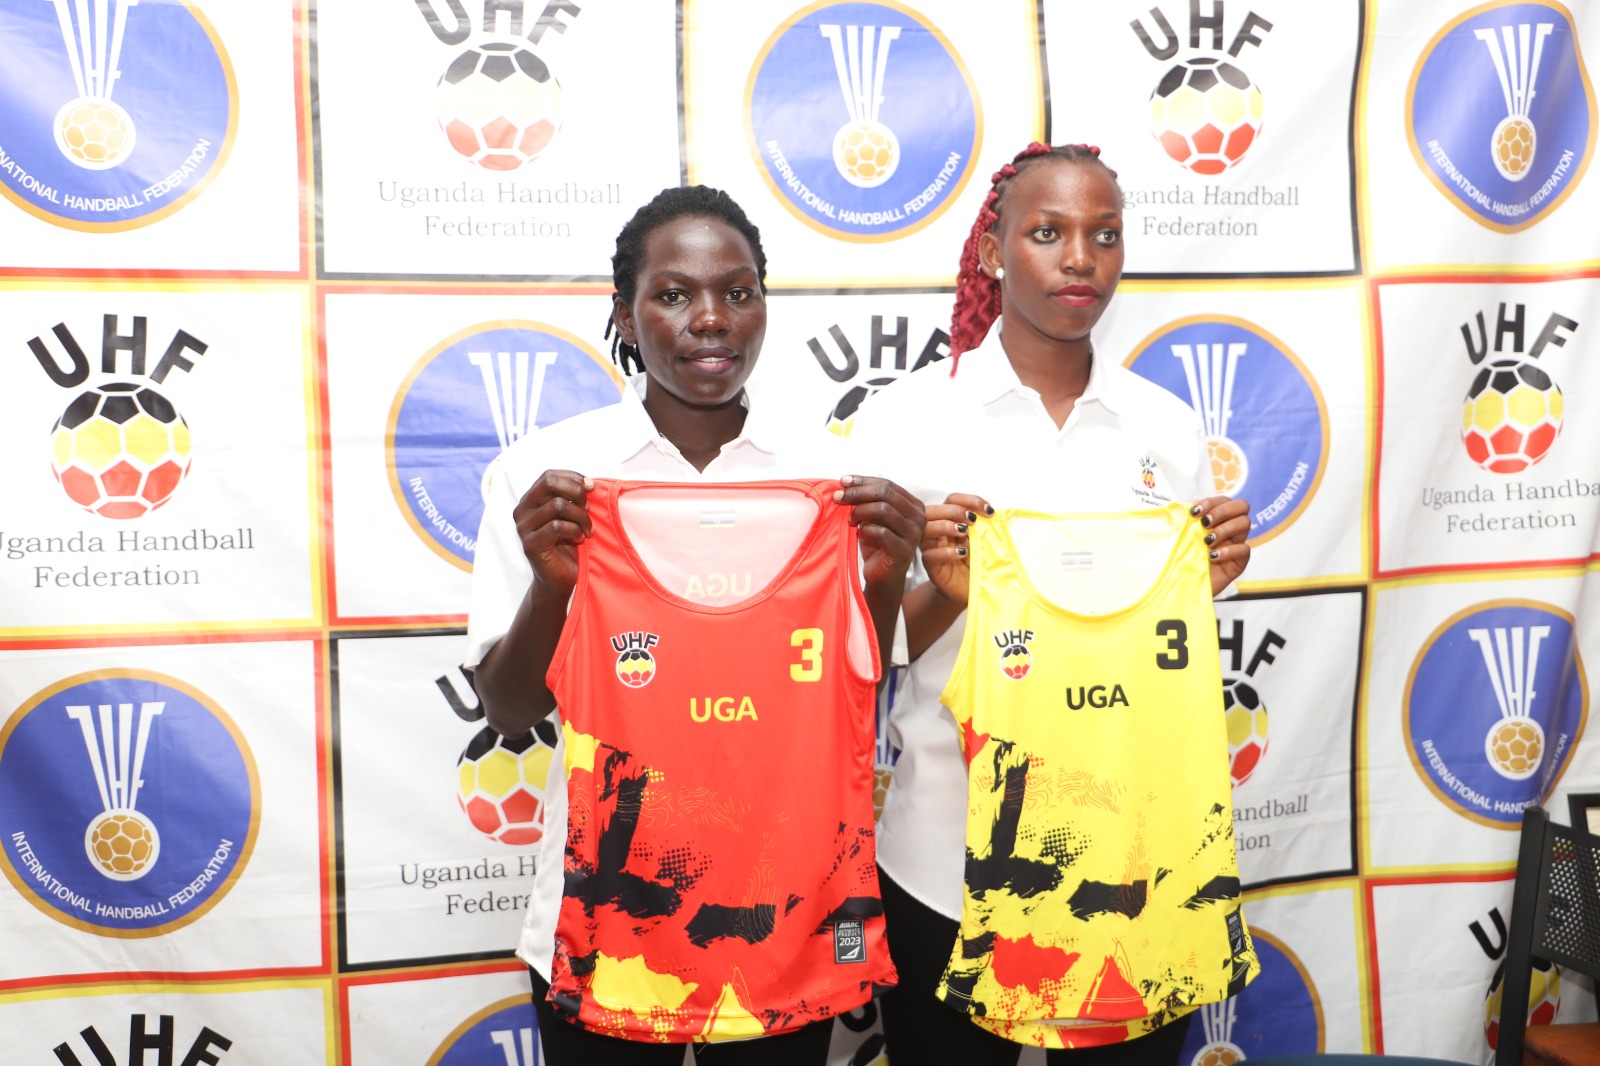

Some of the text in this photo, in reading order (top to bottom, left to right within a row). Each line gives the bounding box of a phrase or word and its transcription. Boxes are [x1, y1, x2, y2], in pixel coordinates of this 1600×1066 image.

[414, 0, 582, 46] UHF
[1129, 0, 1274, 61] UHF
[0, 138, 212, 212] NATIONAL HANDBALL FEDERATION
[765, 139, 962, 226] INTERNATIONAL HANDBALL FEDERATION
[1427, 139, 1575, 217] INTERNATIONAL HANDBALL FEDERATION
[378, 181, 622, 208] Uganda Handball
[1121, 184, 1300, 210] ganda Handball
[425, 216, 572, 237] Federation
[1142, 215, 1259, 237] Federation
[1460, 302, 1579, 365] UHF
[27, 313, 209, 388] UHF
[1256, 461, 1309, 525] FEDERATION
[1422, 478, 1600, 511] Uganda Handba
[409, 476, 478, 552] INTERNATIONA
[1447, 510, 1576, 533] Federation
[117, 528, 255, 552] Handball
[33, 564, 200, 588] Federation
[611, 631, 660, 652] UHF
[994, 629, 1034, 648] UHF
[1156, 619, 1189, 670] 3
[1216, 619, 1287, 678] HF
[790, 628, 824, 682] 3
[690, 696, 759, 723] UGA
[1066, 684, 1130, 711] UGA
[1421, 739, 1493, 810] INTERNATIONAL
[1232, 794, 1308, 821] andball
[11, 831, 234, 919] INTERNATIONAL HANDBALL FEDERATION
[400, 858, 507, 889] Uganda
[445, 890, 531, 915] Feder
[839, 936, 861, 946] 2023
